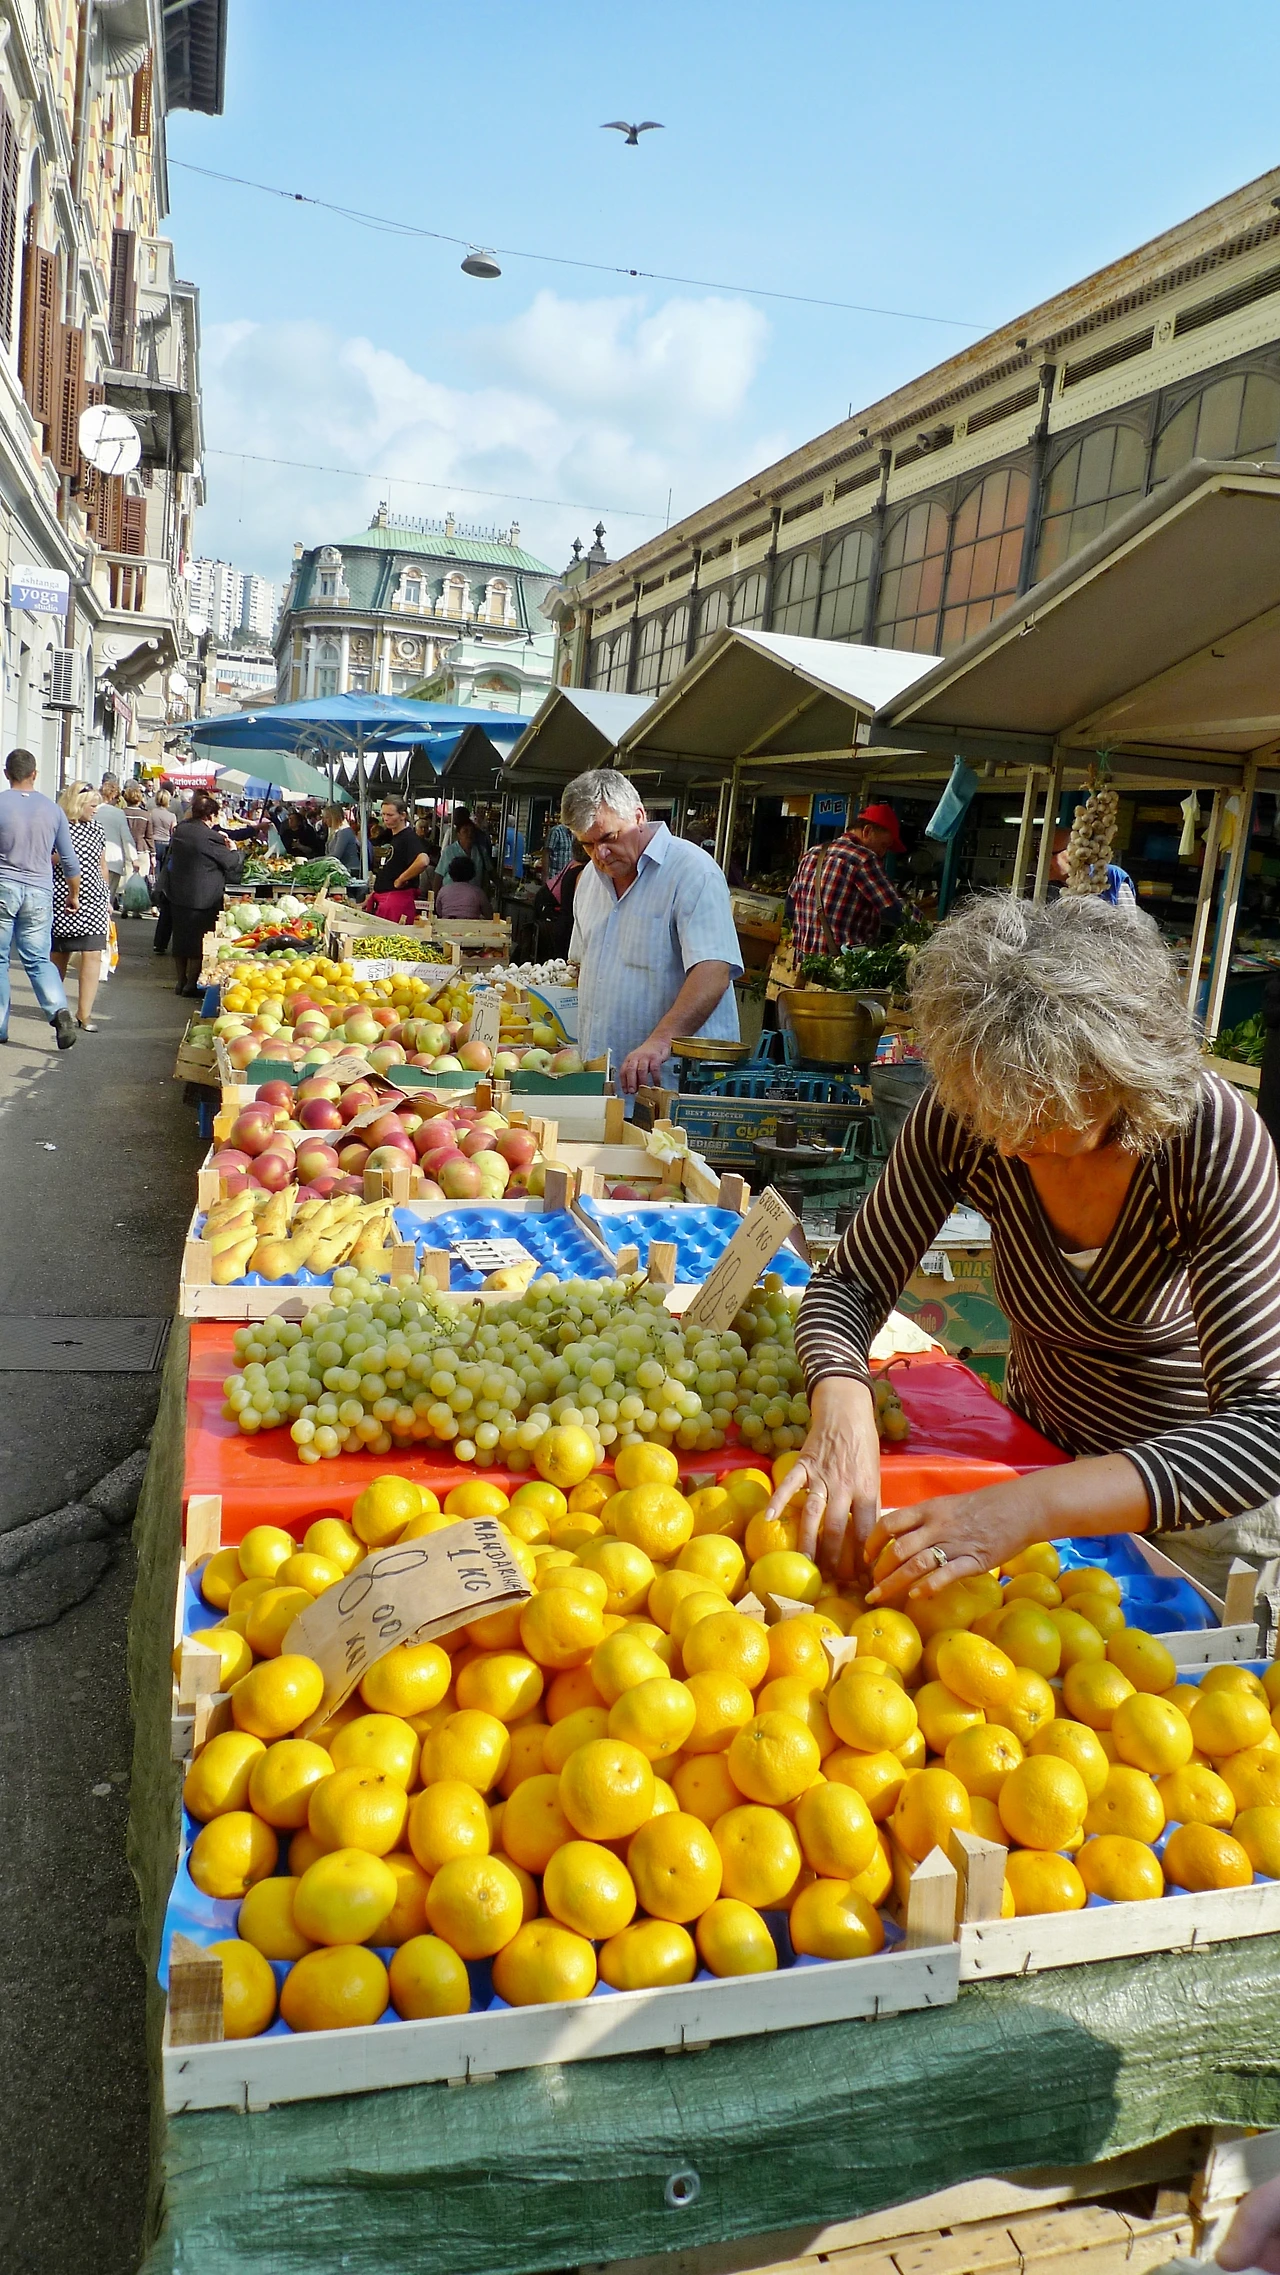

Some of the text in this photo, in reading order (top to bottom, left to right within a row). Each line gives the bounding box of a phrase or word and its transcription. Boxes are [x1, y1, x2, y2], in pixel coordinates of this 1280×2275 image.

[20, 577, 60, 589] ashtanga
[19, 587, 59, 606] yoga
[33, 603, 58, 612] studio
[685, 1109, 744, 1119] BEST SELECTED
[687, 1139, 730, 1150] EDIGEP
[755, 1225, 773, 1251] KG
[457, 1567, 492, 1592] KG
